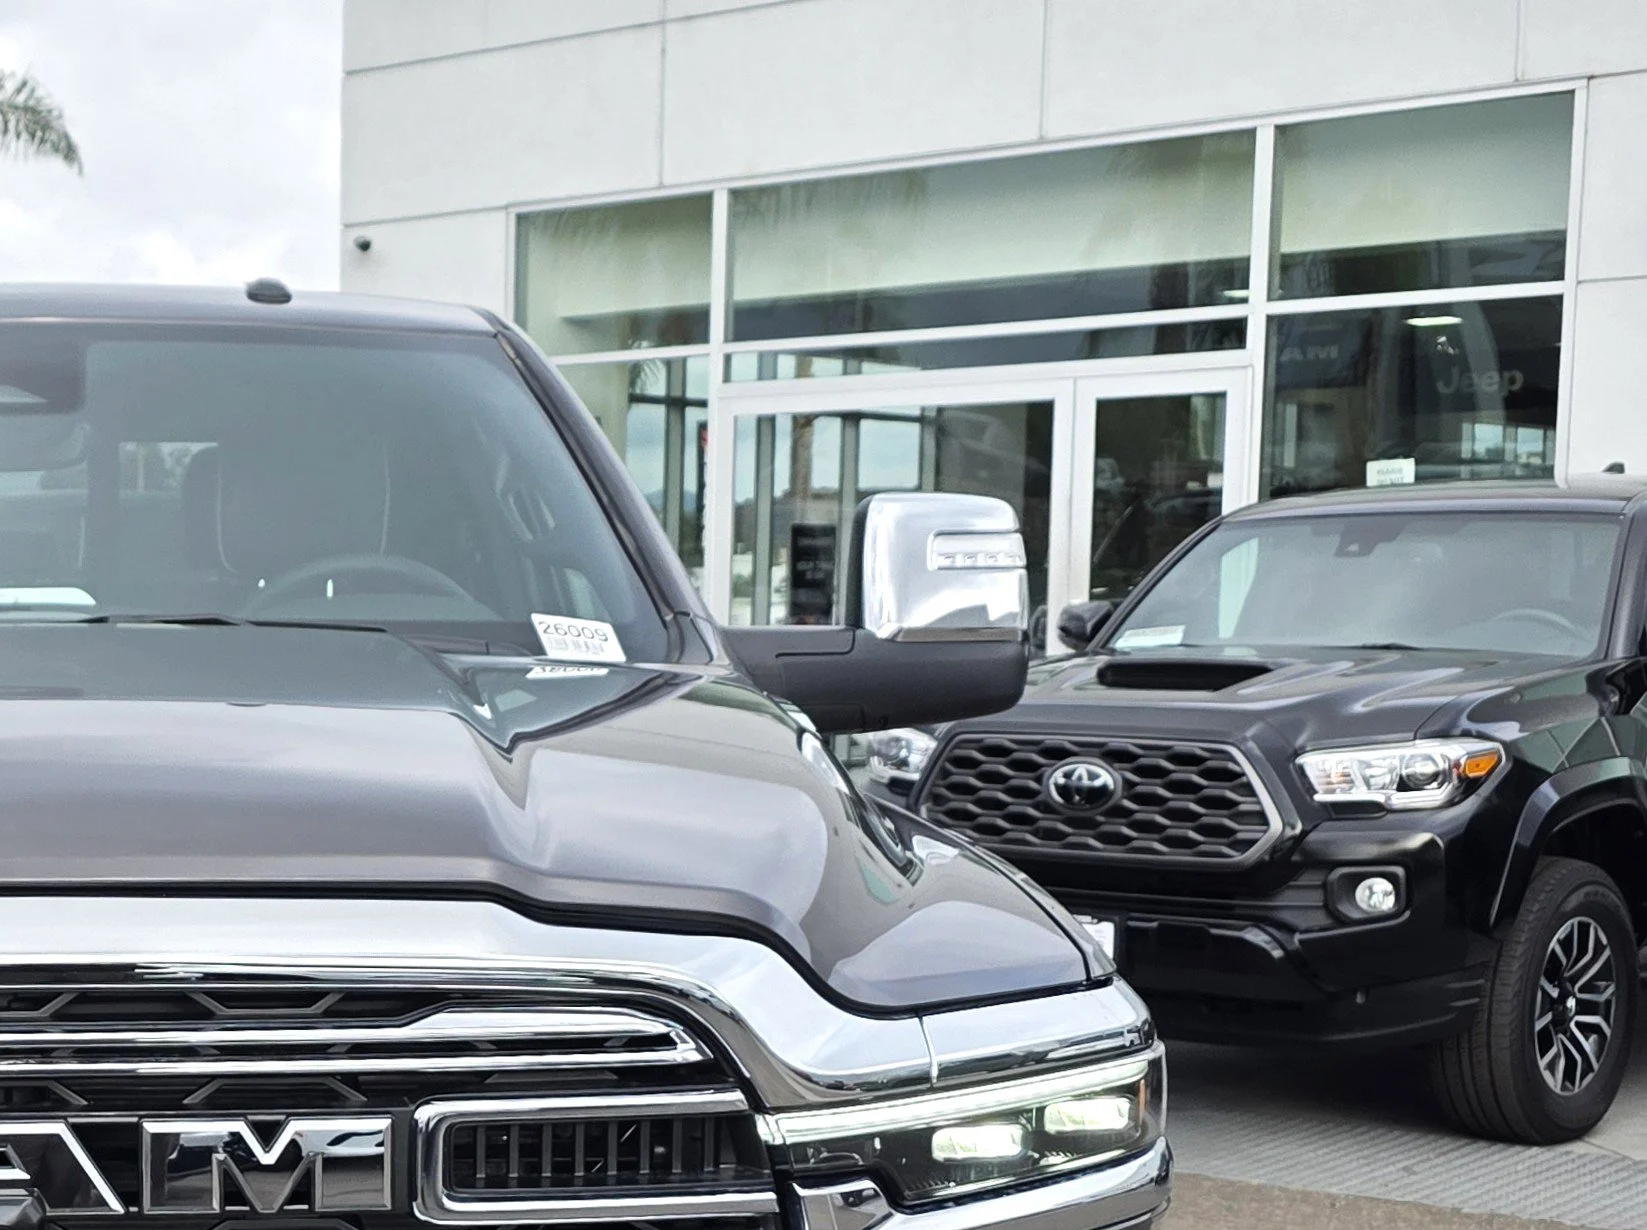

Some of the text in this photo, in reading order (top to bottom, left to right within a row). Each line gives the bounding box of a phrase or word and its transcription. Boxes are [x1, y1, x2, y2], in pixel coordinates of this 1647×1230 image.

[1280, 344, 1340, 361] AM
[1436, 367, 1524, 398] Jeep
[537, 620, 609, 643] 26009
